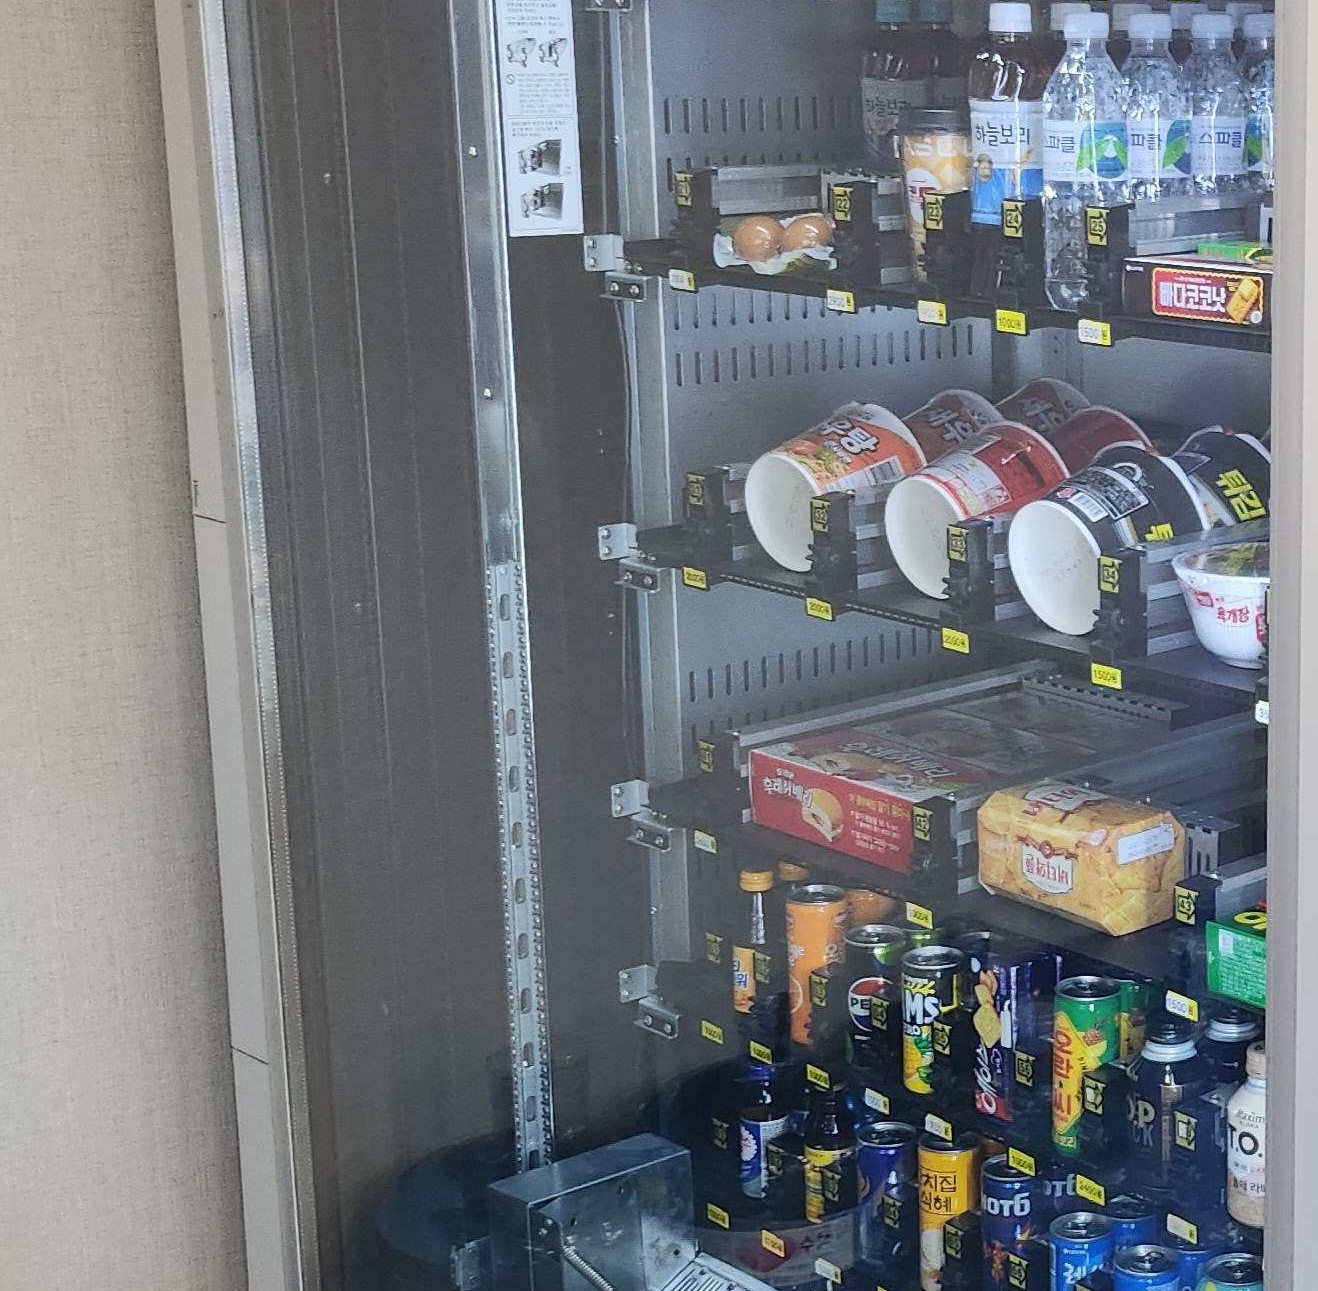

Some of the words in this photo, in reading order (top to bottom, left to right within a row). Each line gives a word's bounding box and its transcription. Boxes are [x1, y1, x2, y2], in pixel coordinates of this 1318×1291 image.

[975, 121, 1030, 146] 하늘보리
[928, 206, 940, 218] 23
[1006, 213, 1020, 226] 24
[1091, 220, 1105, 234] 25
[1159, 281, 1227, 313] 빠다코코낫
[1216, 605, 1250, 623] 육개장
[1177, 899, 1191, 913] 43
